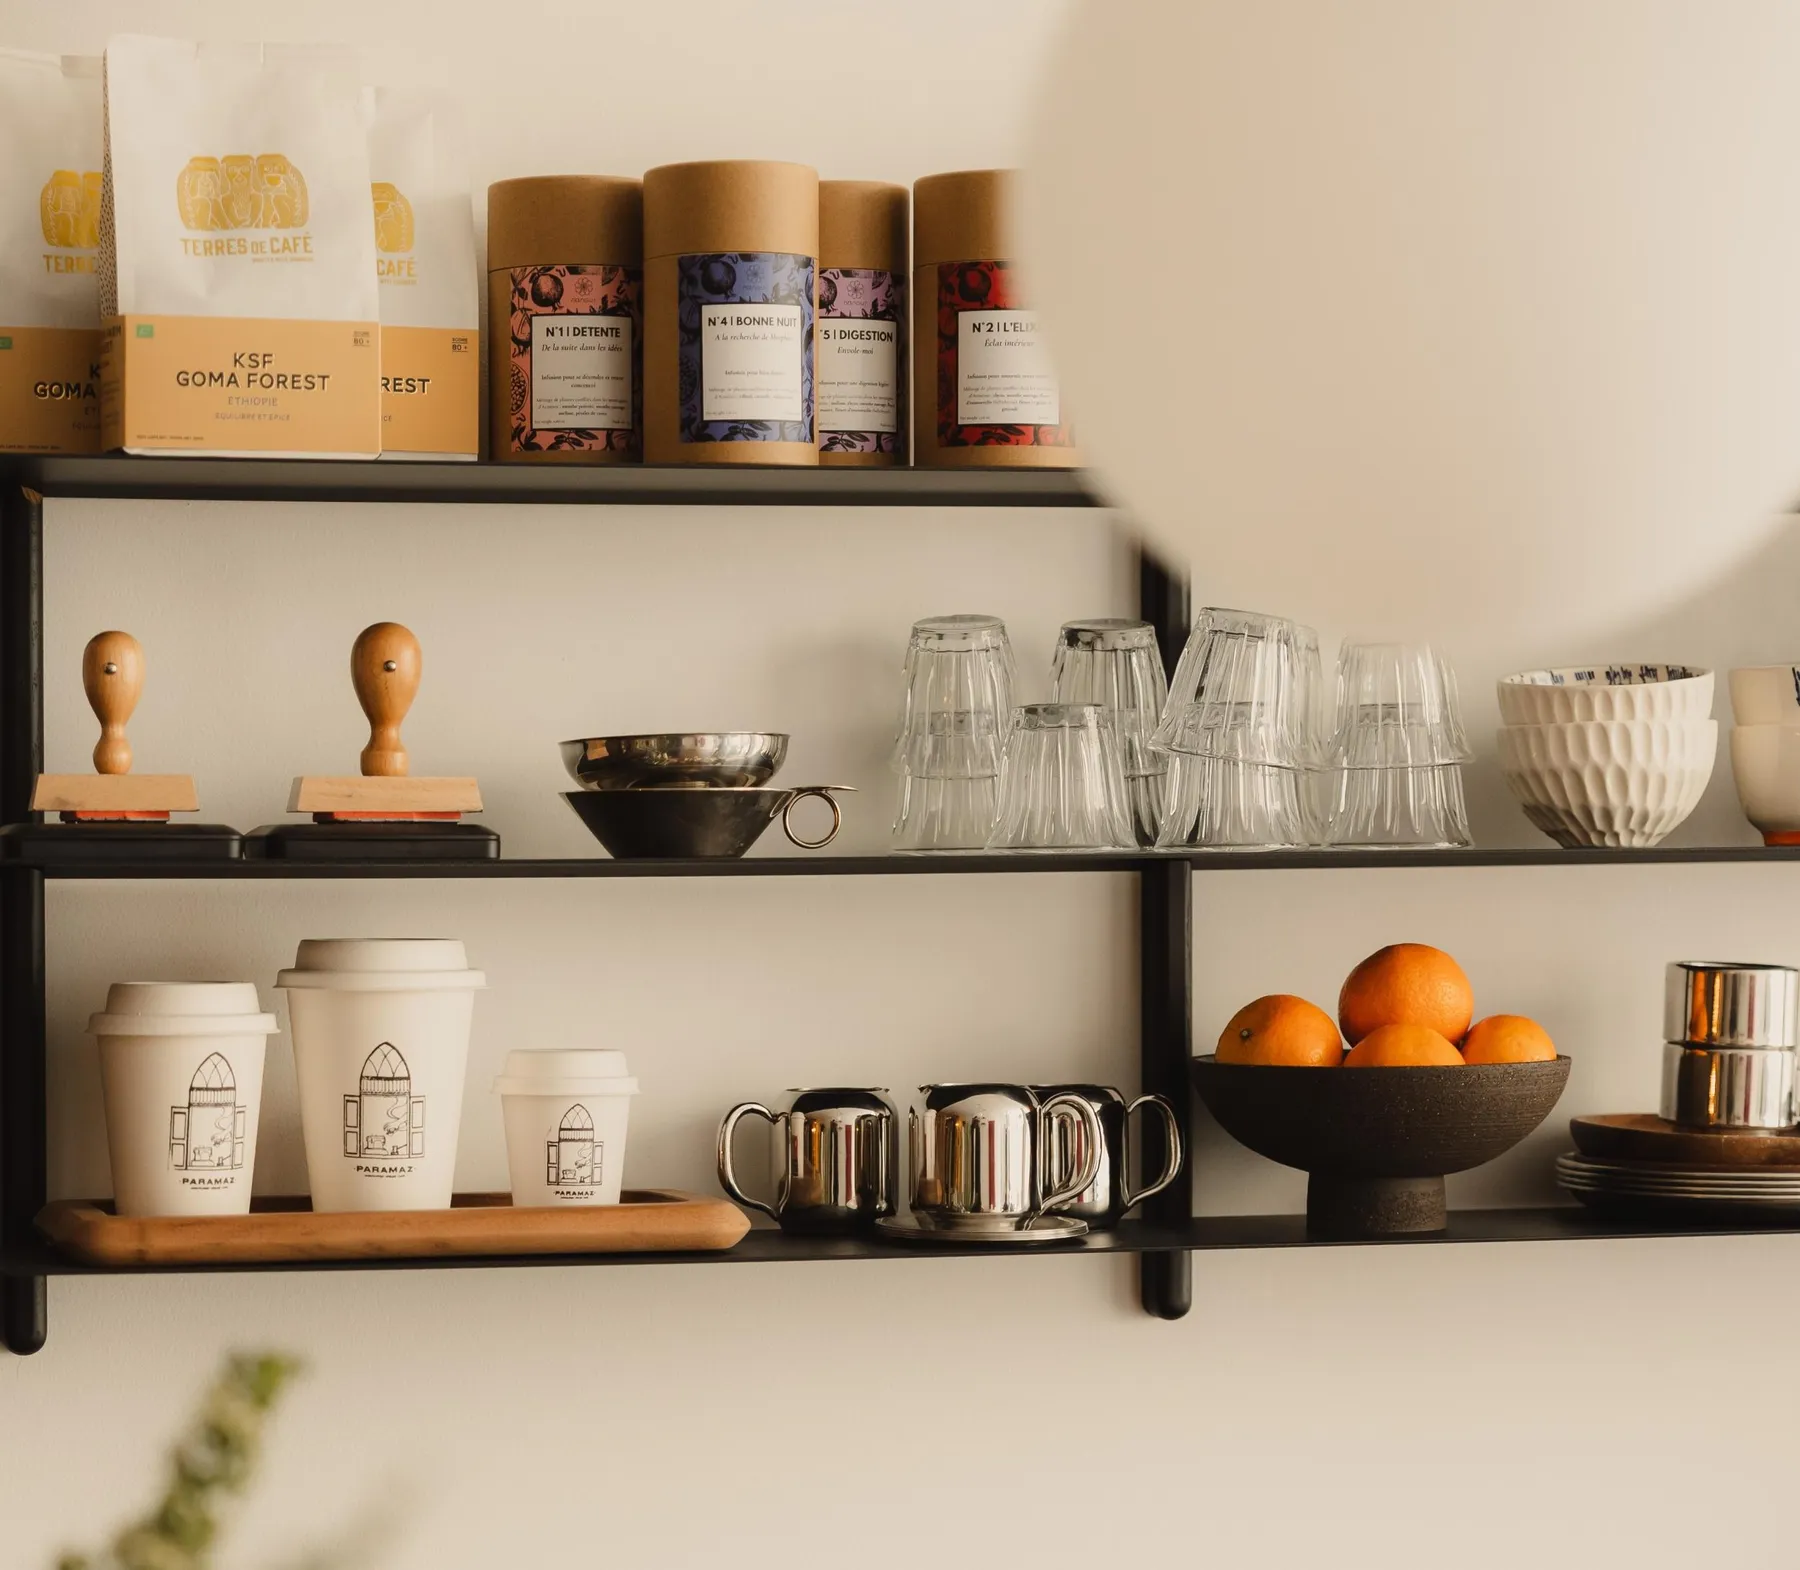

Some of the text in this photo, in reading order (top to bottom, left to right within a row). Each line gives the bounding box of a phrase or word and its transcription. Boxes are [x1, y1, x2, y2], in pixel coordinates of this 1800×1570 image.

[180, 232, 313, 256] TERRES DE CAFÉ
[43, 254, 99, 274] TERRE
[376, 256, 417, 277] CAFÉ
[736, 316, 774, 326] BONNE
[776, 317, 797, 327] NUIT
[1003, 322, 1039, 333] L'ELIX
[573, 326, 621, 338] DETENTE
[730, 332, 760, 341] recherche
[819, 329, 830, 340] °5
[839, 329, 893, 343] DIGESTION
[541, 343, 623, 352] De la suite dans les idées
[233, 352, 275, 369] KSF
[176, 370, 330, 391] GOMA FOREST
[381, 377, 430, 394] REST
[33, 381, 97, 400] GOMA
[356, 1165, 413, 1173] PARAMAZ
[182, 1176, 235, 1185] PARAMAZ
